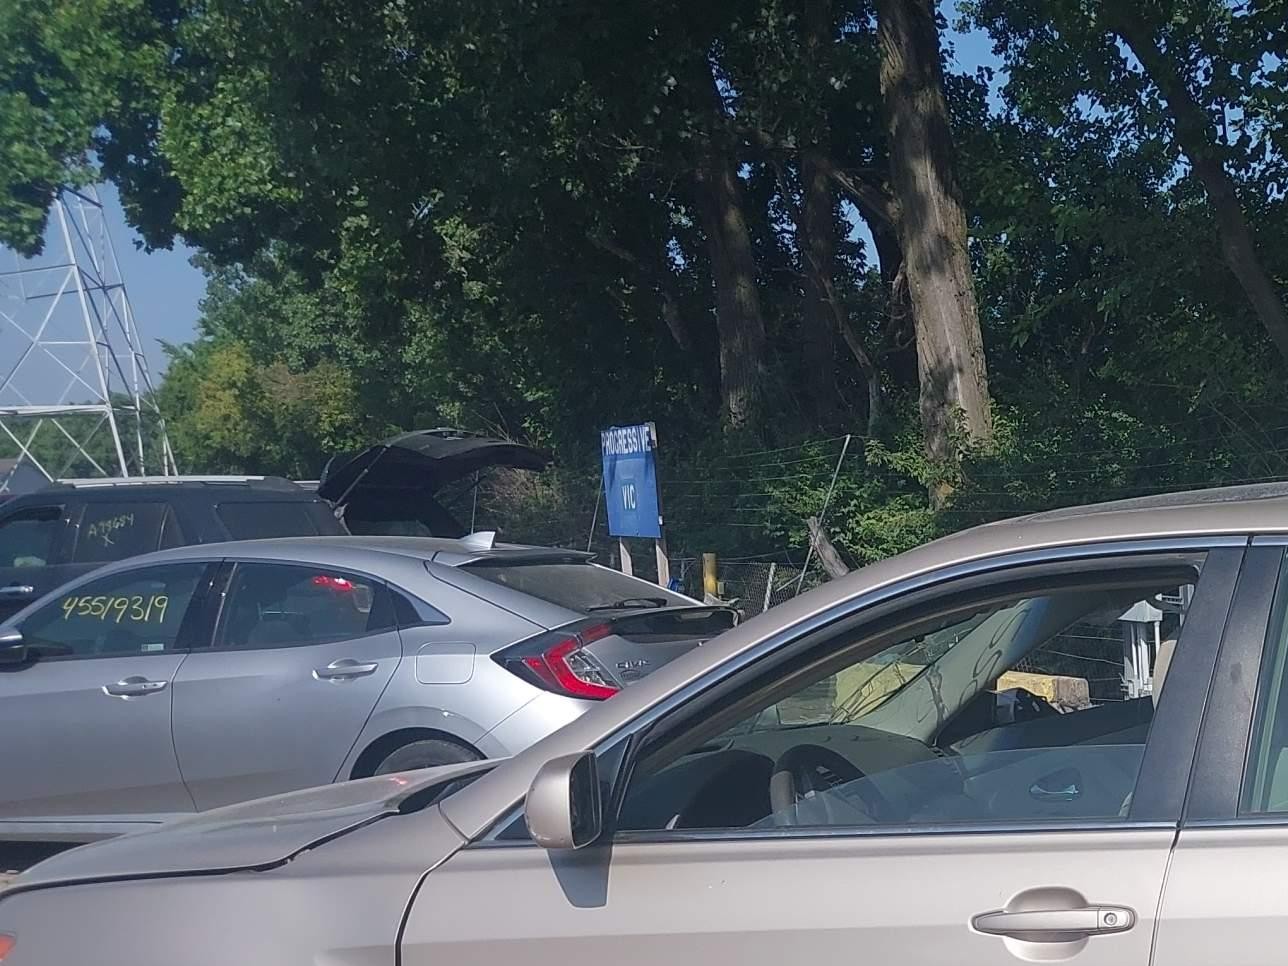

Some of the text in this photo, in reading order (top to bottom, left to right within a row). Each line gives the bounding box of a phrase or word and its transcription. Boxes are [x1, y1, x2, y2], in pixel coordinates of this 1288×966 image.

[601, 427, 651, 455] PROGRESSIVE
[621, 484, 636, 510] VIC
[63, 595, 169, 624] 45519319
